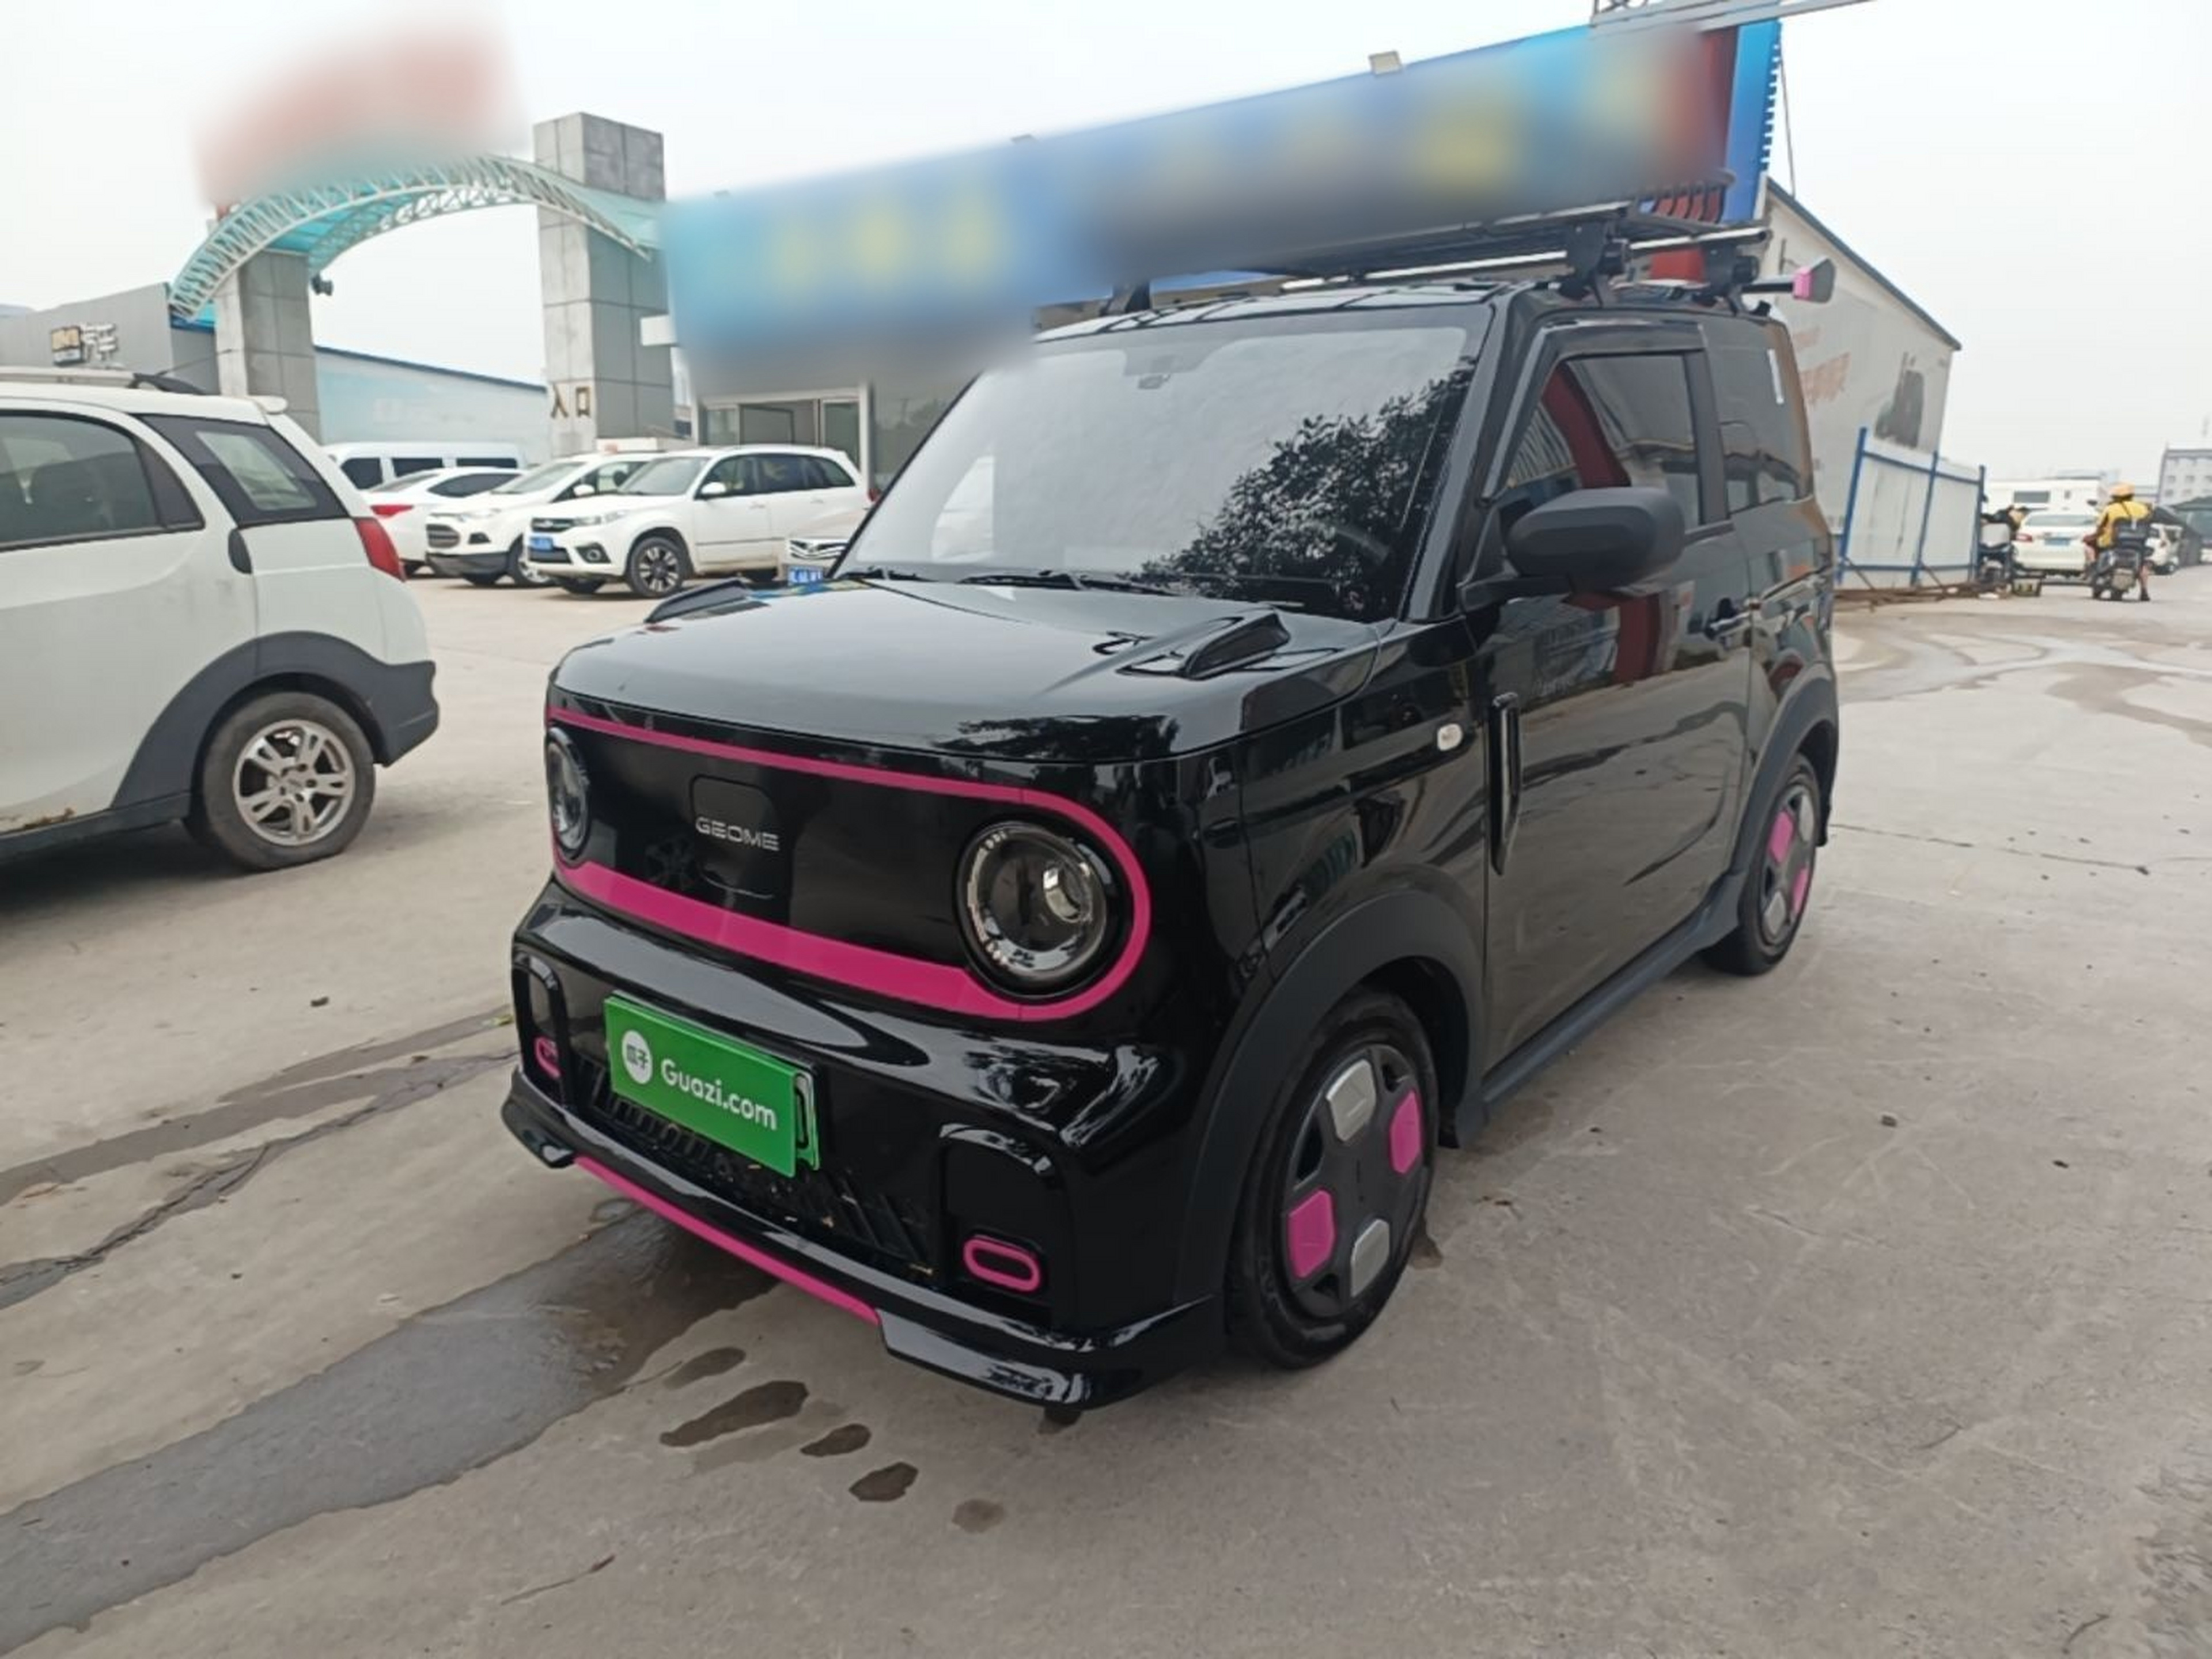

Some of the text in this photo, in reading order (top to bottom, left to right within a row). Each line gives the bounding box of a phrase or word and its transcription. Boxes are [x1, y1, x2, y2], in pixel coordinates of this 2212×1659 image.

[550, 381, 592, 419] 入口
[695, 816, 780, 851] GEOME
[661, 1058, 777, 1131] Guazi.com
